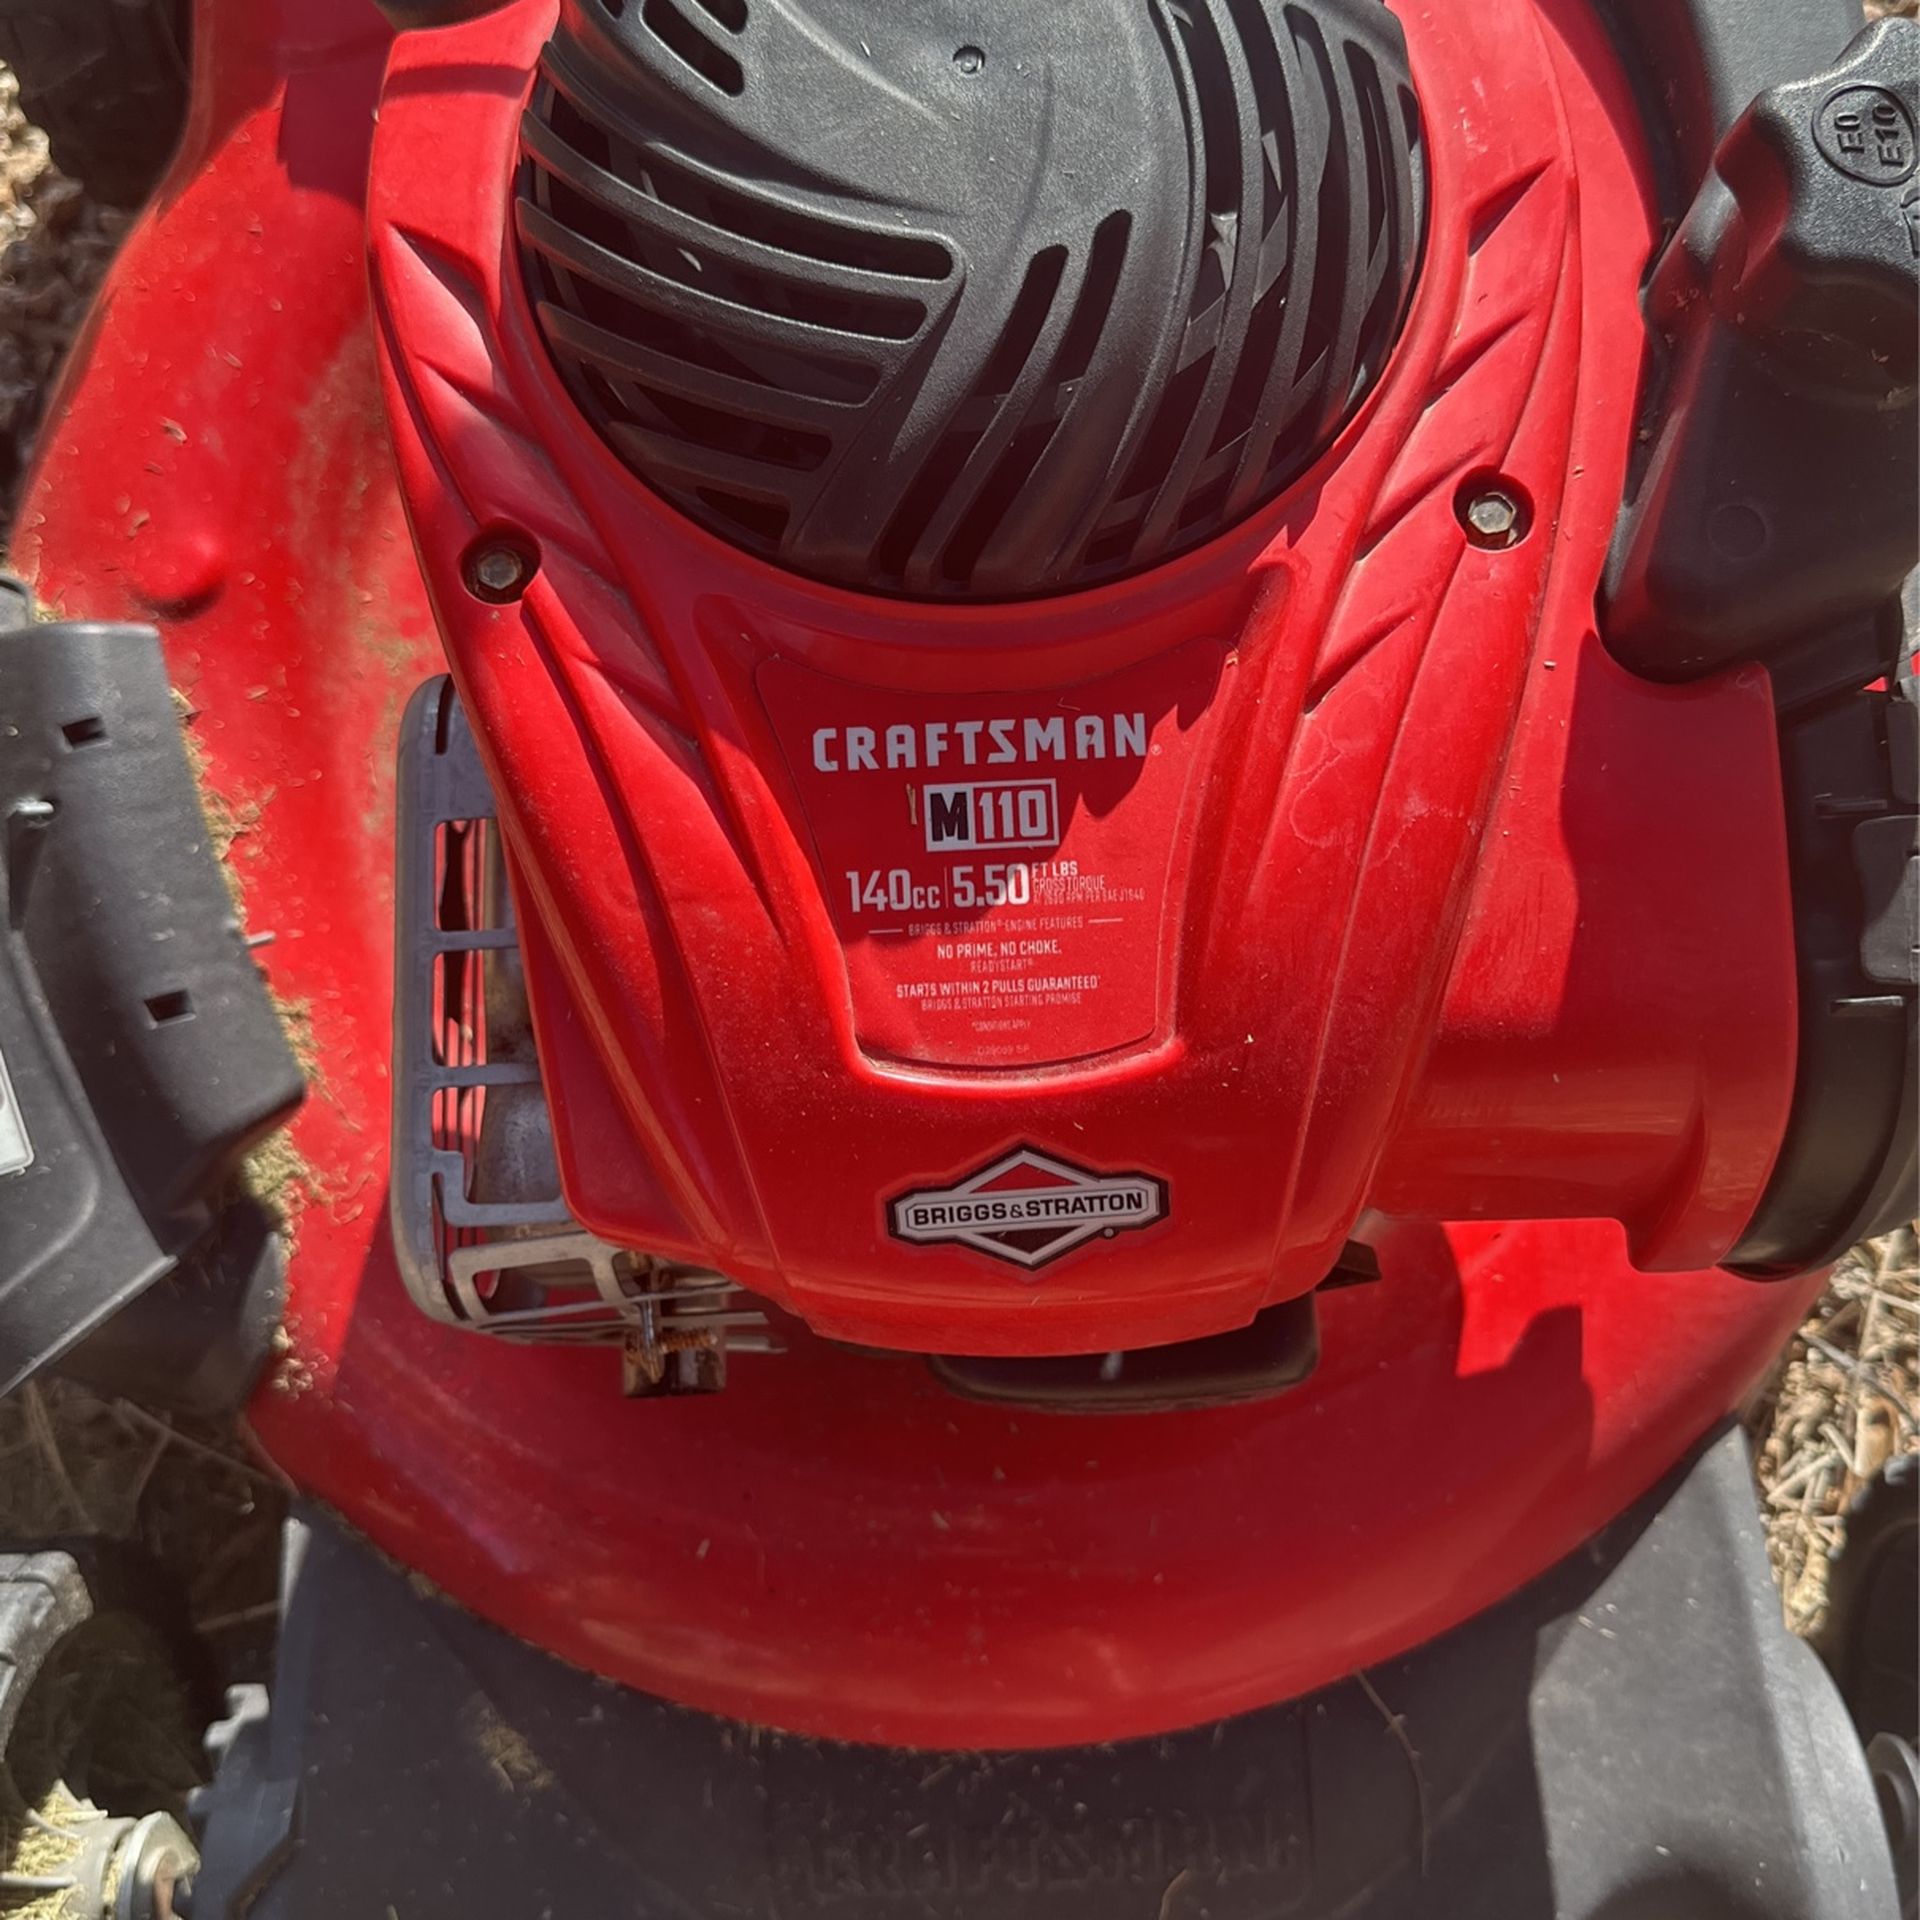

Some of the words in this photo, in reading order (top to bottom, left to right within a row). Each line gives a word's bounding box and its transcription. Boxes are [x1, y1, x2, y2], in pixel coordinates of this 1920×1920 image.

[1834, 114, 1864, 154] E0
[1872, 104, 1904, 167] E10
[813, 712, 1147, 772] CRAFTSMAN
[930, 788, 1049, 842] M110
[1031, 862, 1048, 878] FT
[1052, 861, 1078, 877] LBS
[846, 868, 941, 913] 140cc
[952, 862, 1030, 908] 5.50
[1033, 877, 1065, 893] GROSS
[1067, 875, 1105, 892] TORQUE
[908, 923, 943, 936] BRIGGS
[1005, 919, 1037, 933] ENGINE
[1039, 916, 1084, 931] FEATURES
[937, 944, 953, 959] NO
[957, 942, 997, 958] PRIME.
[1001, 942, 1017, 957] NO
[1019, 939, 1062, 955] CHOKE.
[896, 982, 937, 998] STARTS
[939, 980, 980, 996] WITHIN
[982, 980, 990, 994] 2
[992, 978, 1025, 993] PULLS
[1004, 993, 1044, 1007] STARTING
